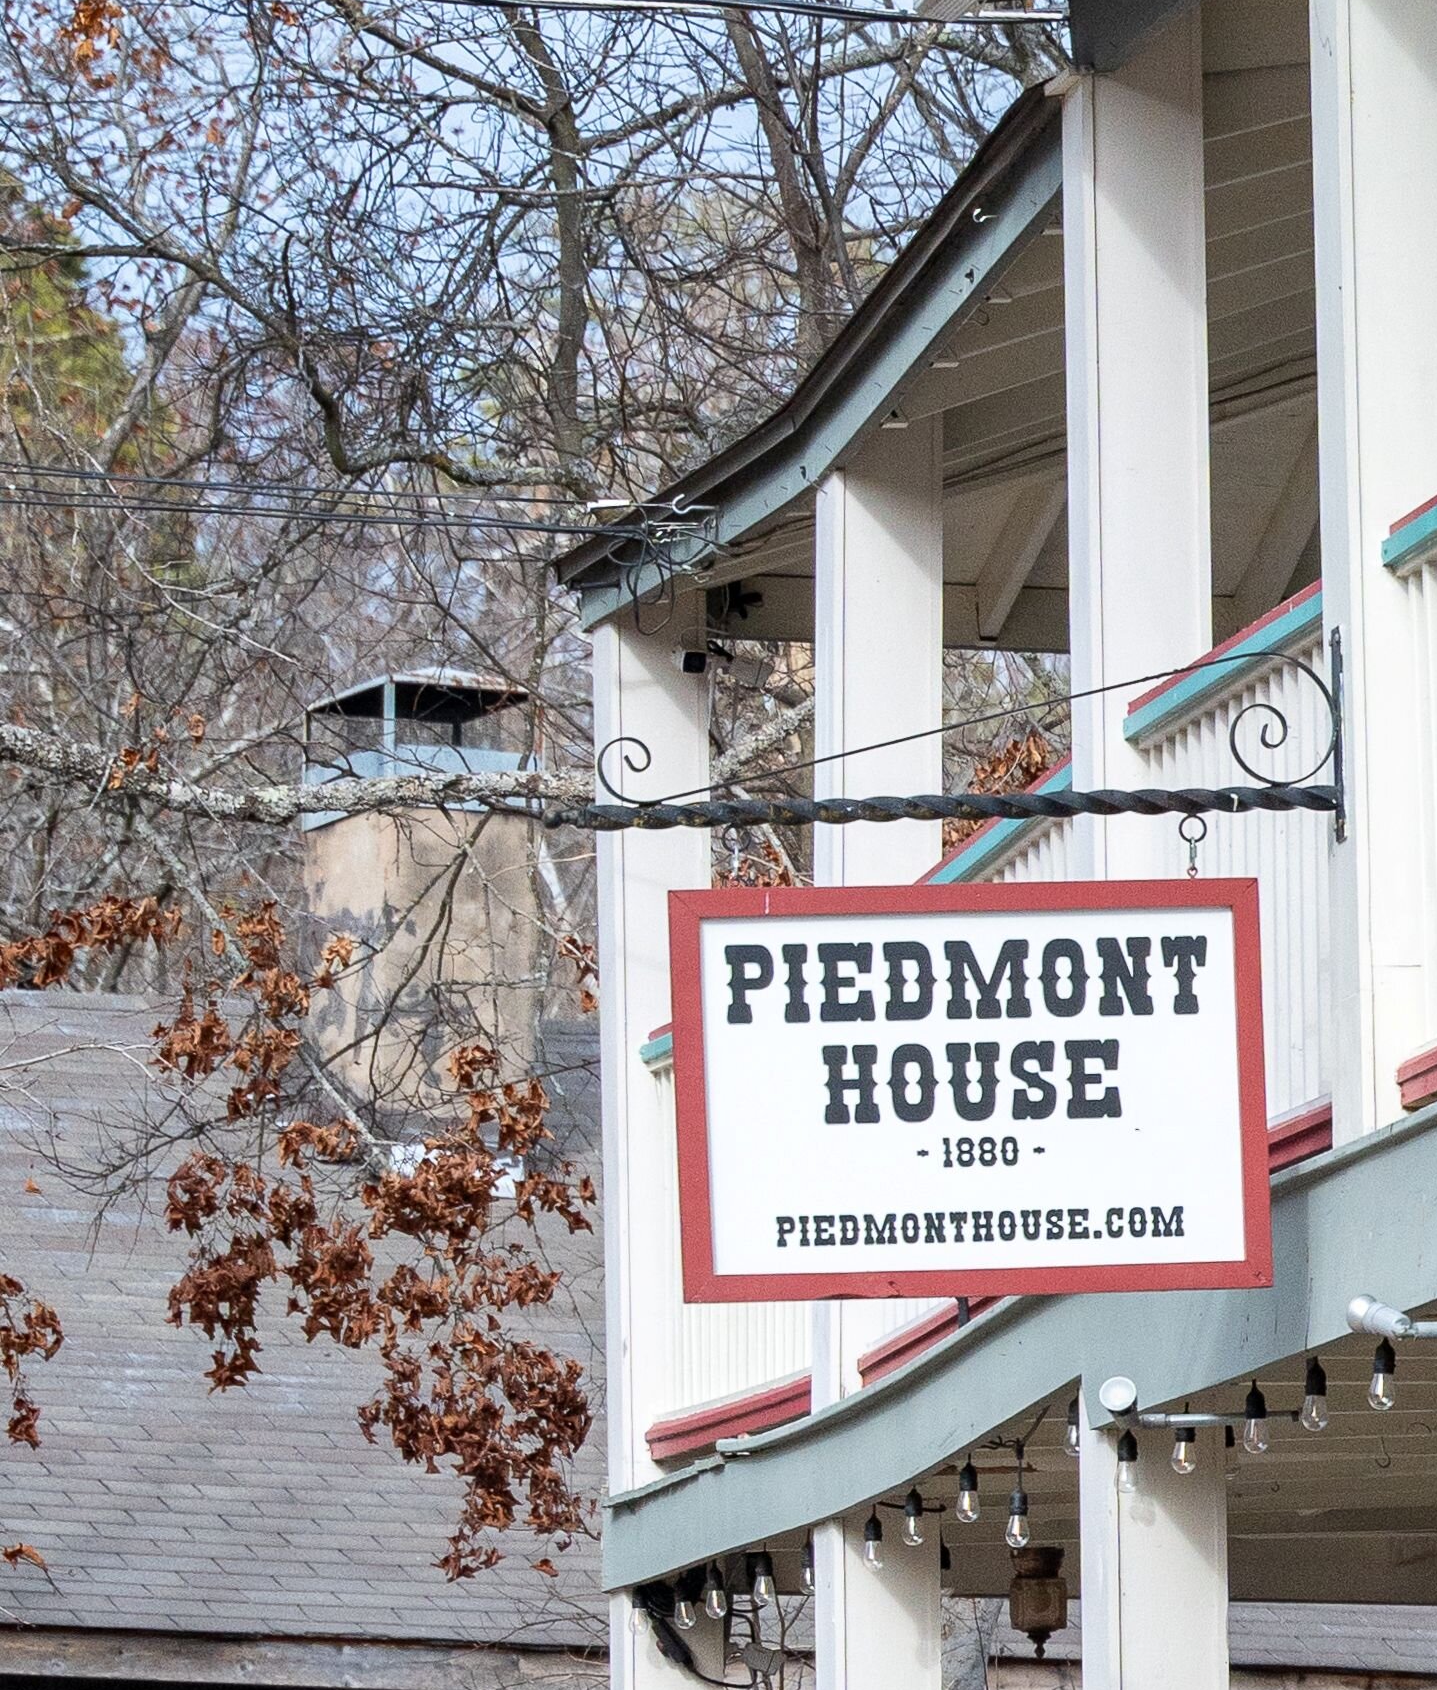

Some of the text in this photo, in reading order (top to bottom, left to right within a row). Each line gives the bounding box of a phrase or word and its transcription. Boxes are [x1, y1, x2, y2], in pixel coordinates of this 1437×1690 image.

[725, 936, 1207, 1024] PIEDMONT
[823, 1039, 1121, 1124] HOUSE
[943, 1137, 1019, 1167] 1880
[776, 1206, 1184, 1247] PIEDMONTHOUSE.COM
